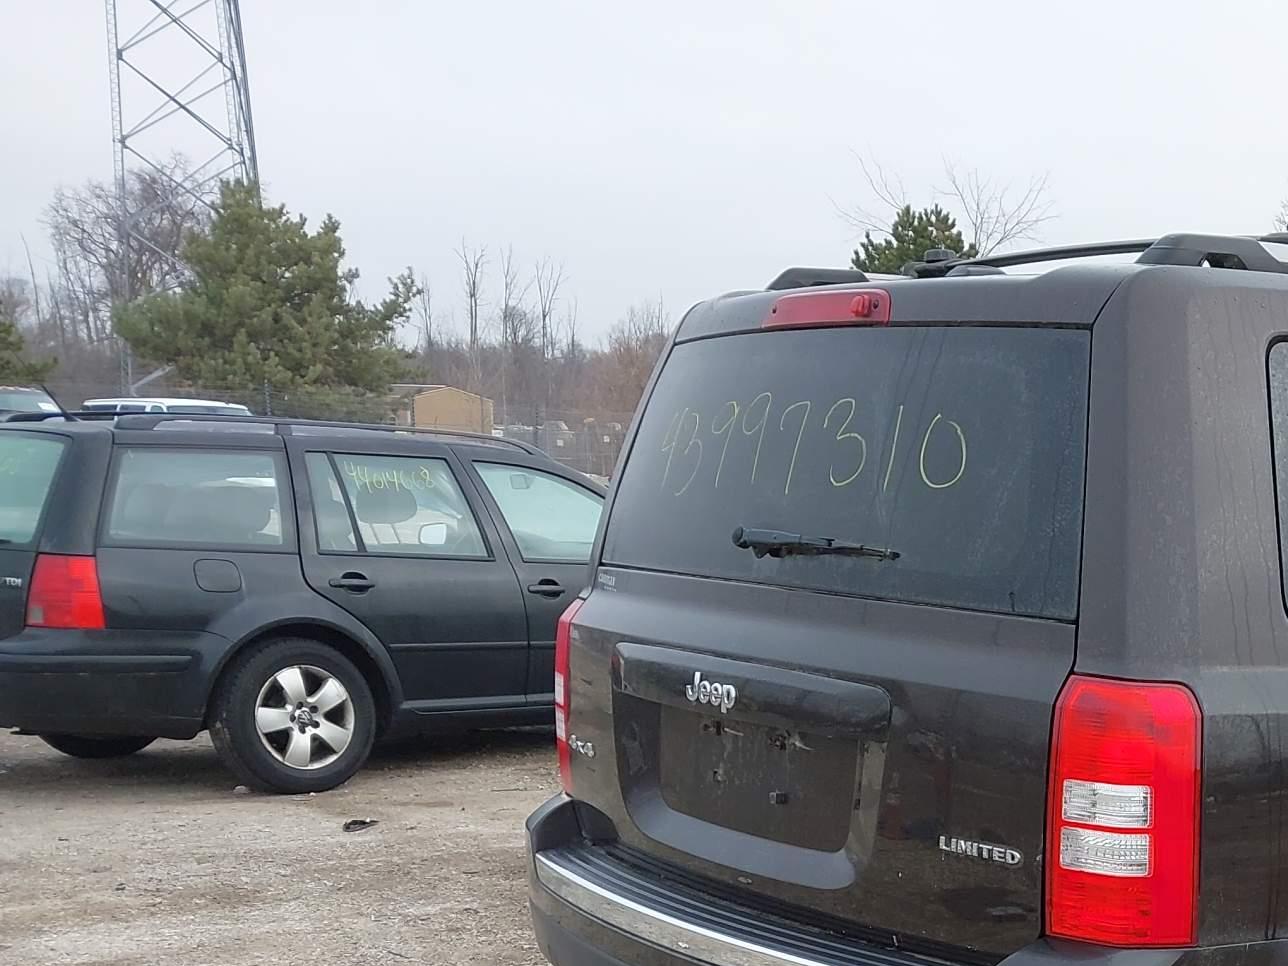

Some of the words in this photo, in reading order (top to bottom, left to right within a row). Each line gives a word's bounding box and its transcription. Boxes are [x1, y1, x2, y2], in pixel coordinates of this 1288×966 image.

[659, 391, 967, 496] 43997310
[685, 671, 736, 714] Jeep
[939, 835, 1022, 865] LIMITED
